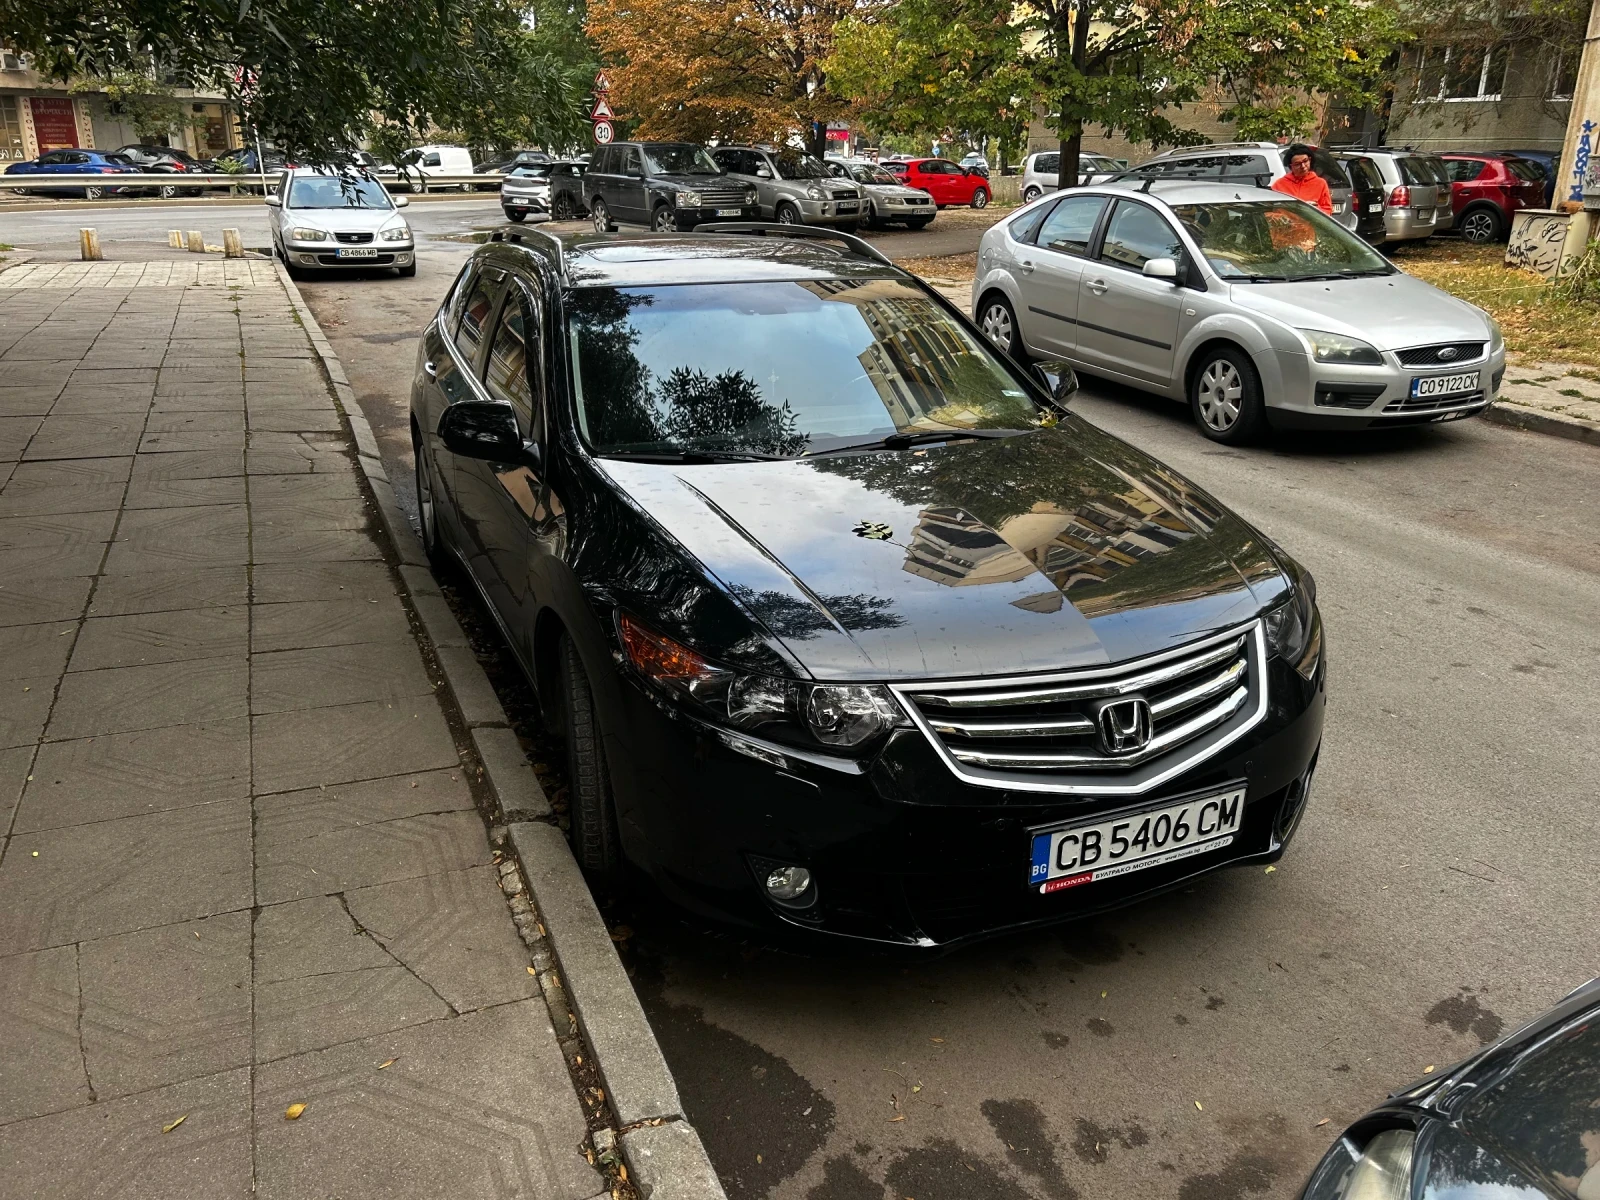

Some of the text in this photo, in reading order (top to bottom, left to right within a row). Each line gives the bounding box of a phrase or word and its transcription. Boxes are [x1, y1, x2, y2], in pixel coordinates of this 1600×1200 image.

[597, 127, 609, 139] 30
[1420, 379, 1436, 394] CO
[1438, 377, 1463, 393] 9122
[1055, 794, 1240, 871] CB 5406 CM
[1032, 863, 1047, 876] BG
[1055, 876, 1091, 889] HONDA
